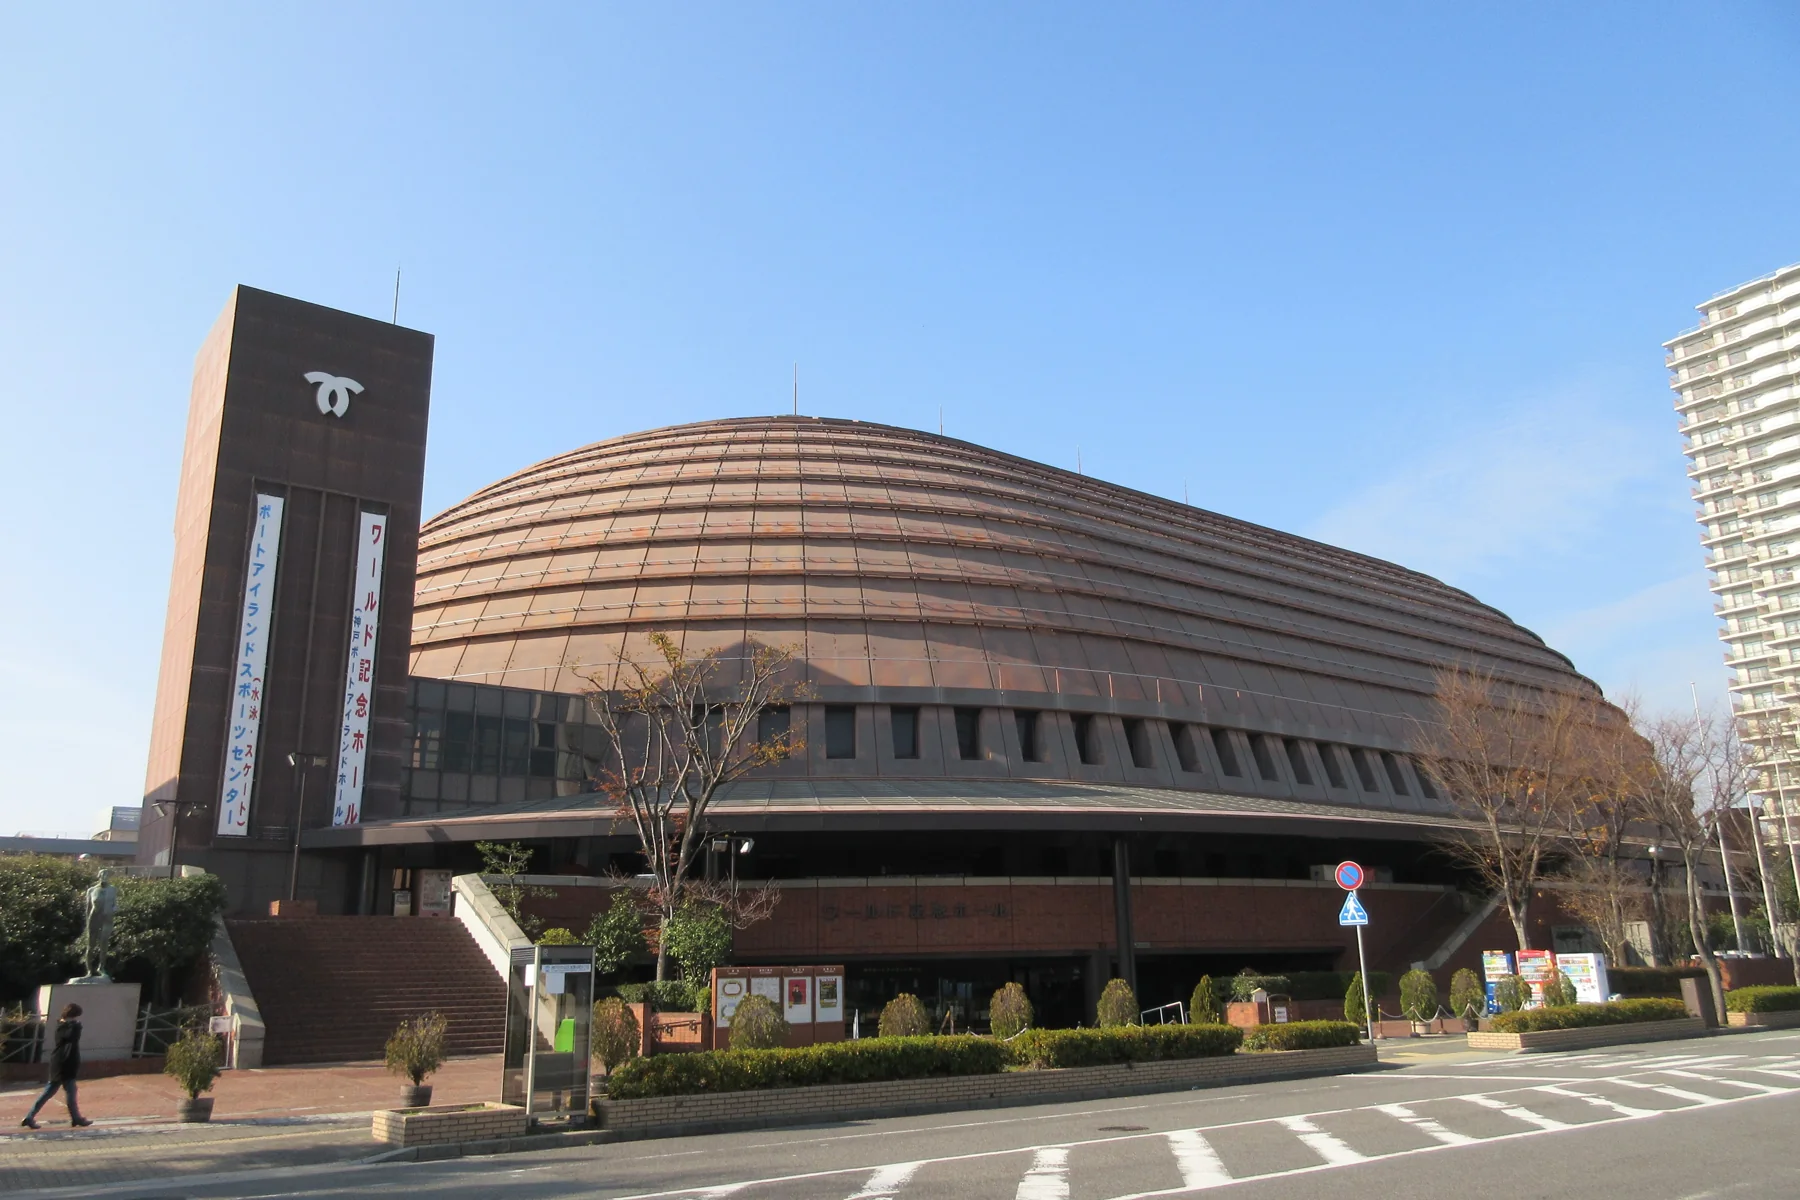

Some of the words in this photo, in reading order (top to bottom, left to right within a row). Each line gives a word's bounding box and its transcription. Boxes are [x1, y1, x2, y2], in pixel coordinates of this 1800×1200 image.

[226, 504, 271, 825] ポートアイランドスポーツセンター
[345, 524, 381, 825] ワールド記念ホール
